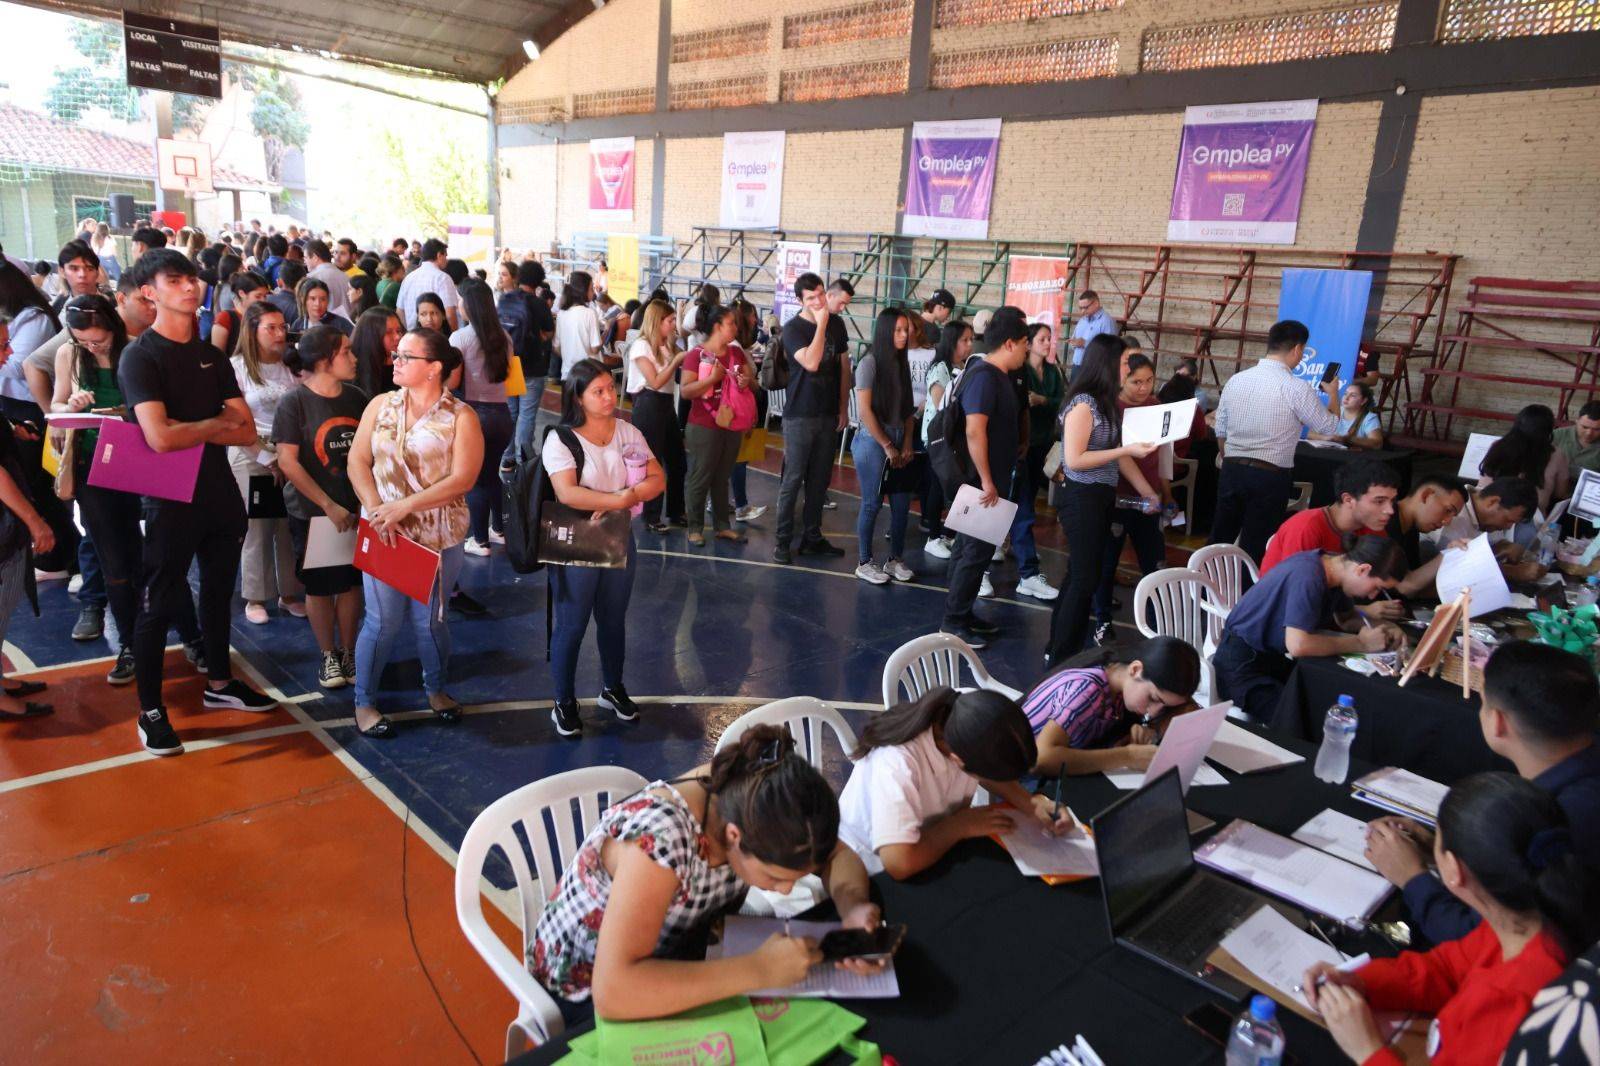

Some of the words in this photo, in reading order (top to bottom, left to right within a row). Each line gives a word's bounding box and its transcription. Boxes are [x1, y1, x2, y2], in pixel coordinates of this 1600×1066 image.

[130, 32, 157, 43] LOCAL
[181, 40, 220, 53] VISITANTE
[130, 60, 161, 72] FALTAS
[189, 69, 218, 80] FALTAS
[787, 252, 809, 266] BOX
